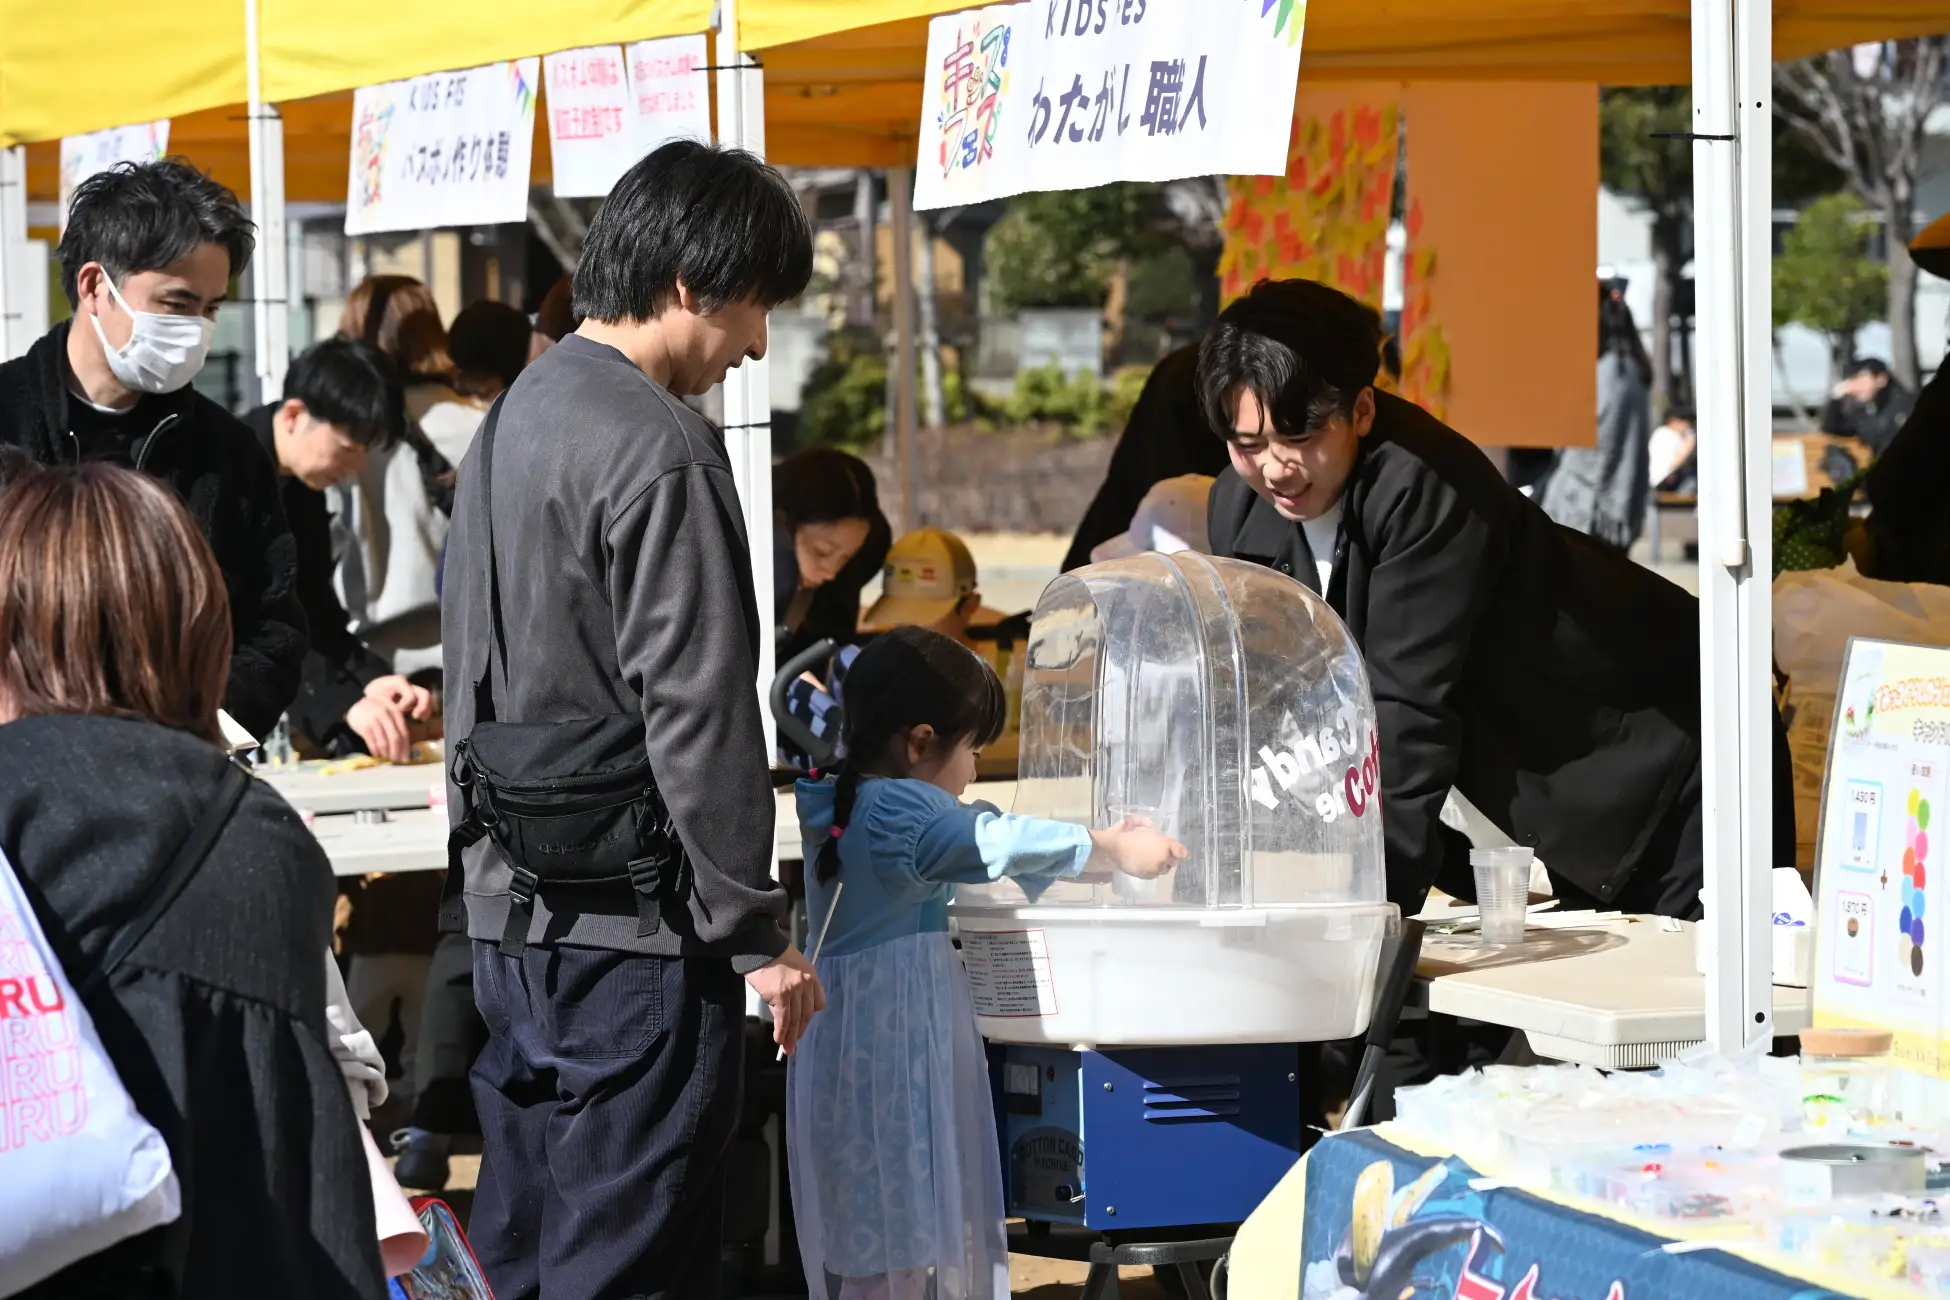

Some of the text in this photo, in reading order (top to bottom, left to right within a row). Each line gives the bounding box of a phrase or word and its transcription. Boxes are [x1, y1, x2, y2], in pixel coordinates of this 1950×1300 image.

[1027, 54, 1208, 149] わたがし 職人
